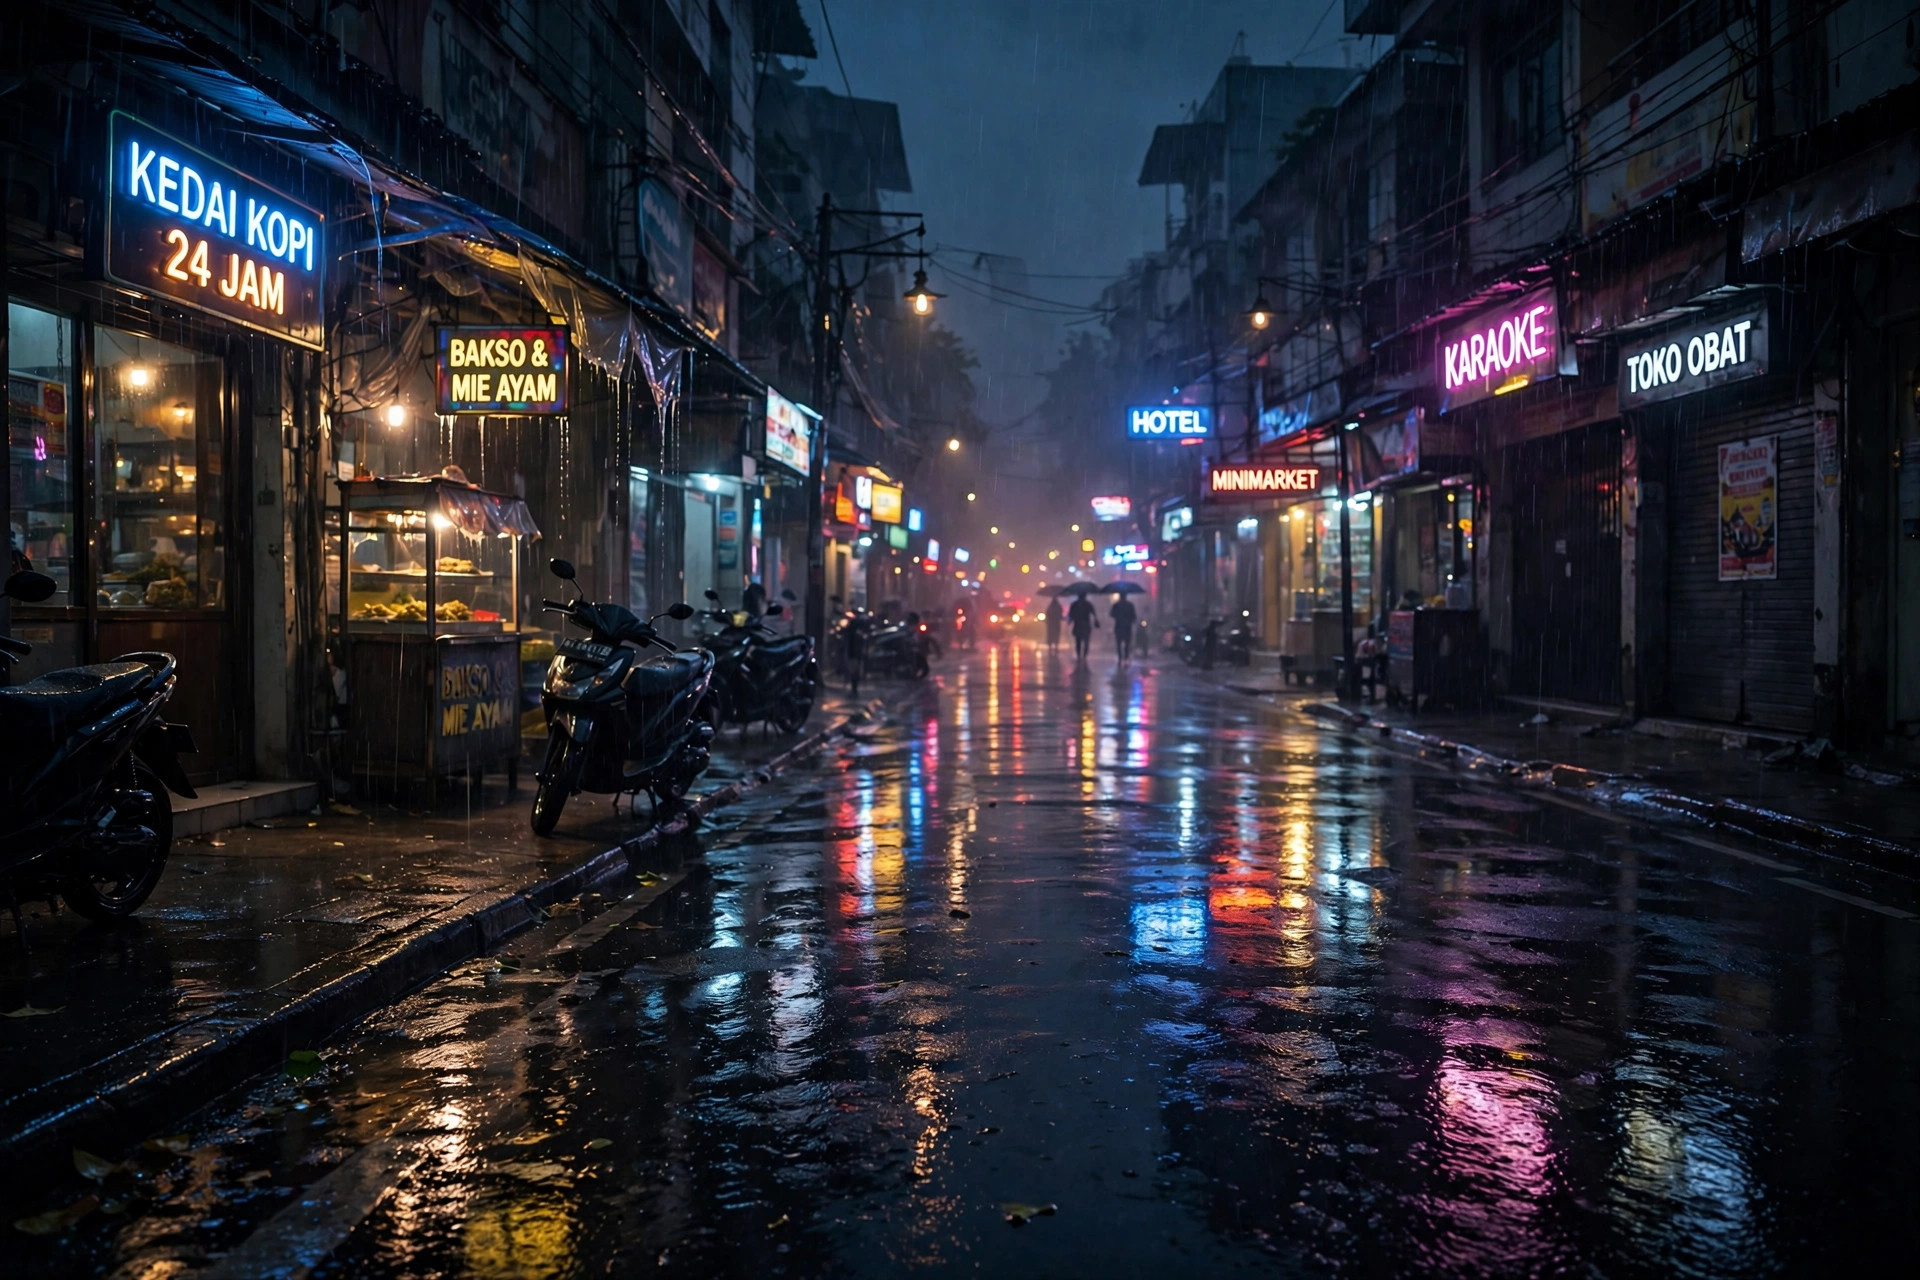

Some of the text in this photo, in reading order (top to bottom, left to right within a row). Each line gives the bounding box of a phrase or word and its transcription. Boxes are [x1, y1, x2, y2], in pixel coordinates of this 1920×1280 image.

[130, 140, 314, 272] KEDAI KOPI
[165, 228, 285, 316] 24 JAM
[450, 338, 549, 368] BAKSO &
[1444, 304, 1548, 390] KARAOKE
[1627, 320, 1752, 393] TOKO OBAT
[452, 373, 557, 402] MIE AYAM
[1132, 410, 1208, 434] HOTEL
[1212, 469, 1319, 491] MINIMARKET
[442, 704, 469, 736] MIE
